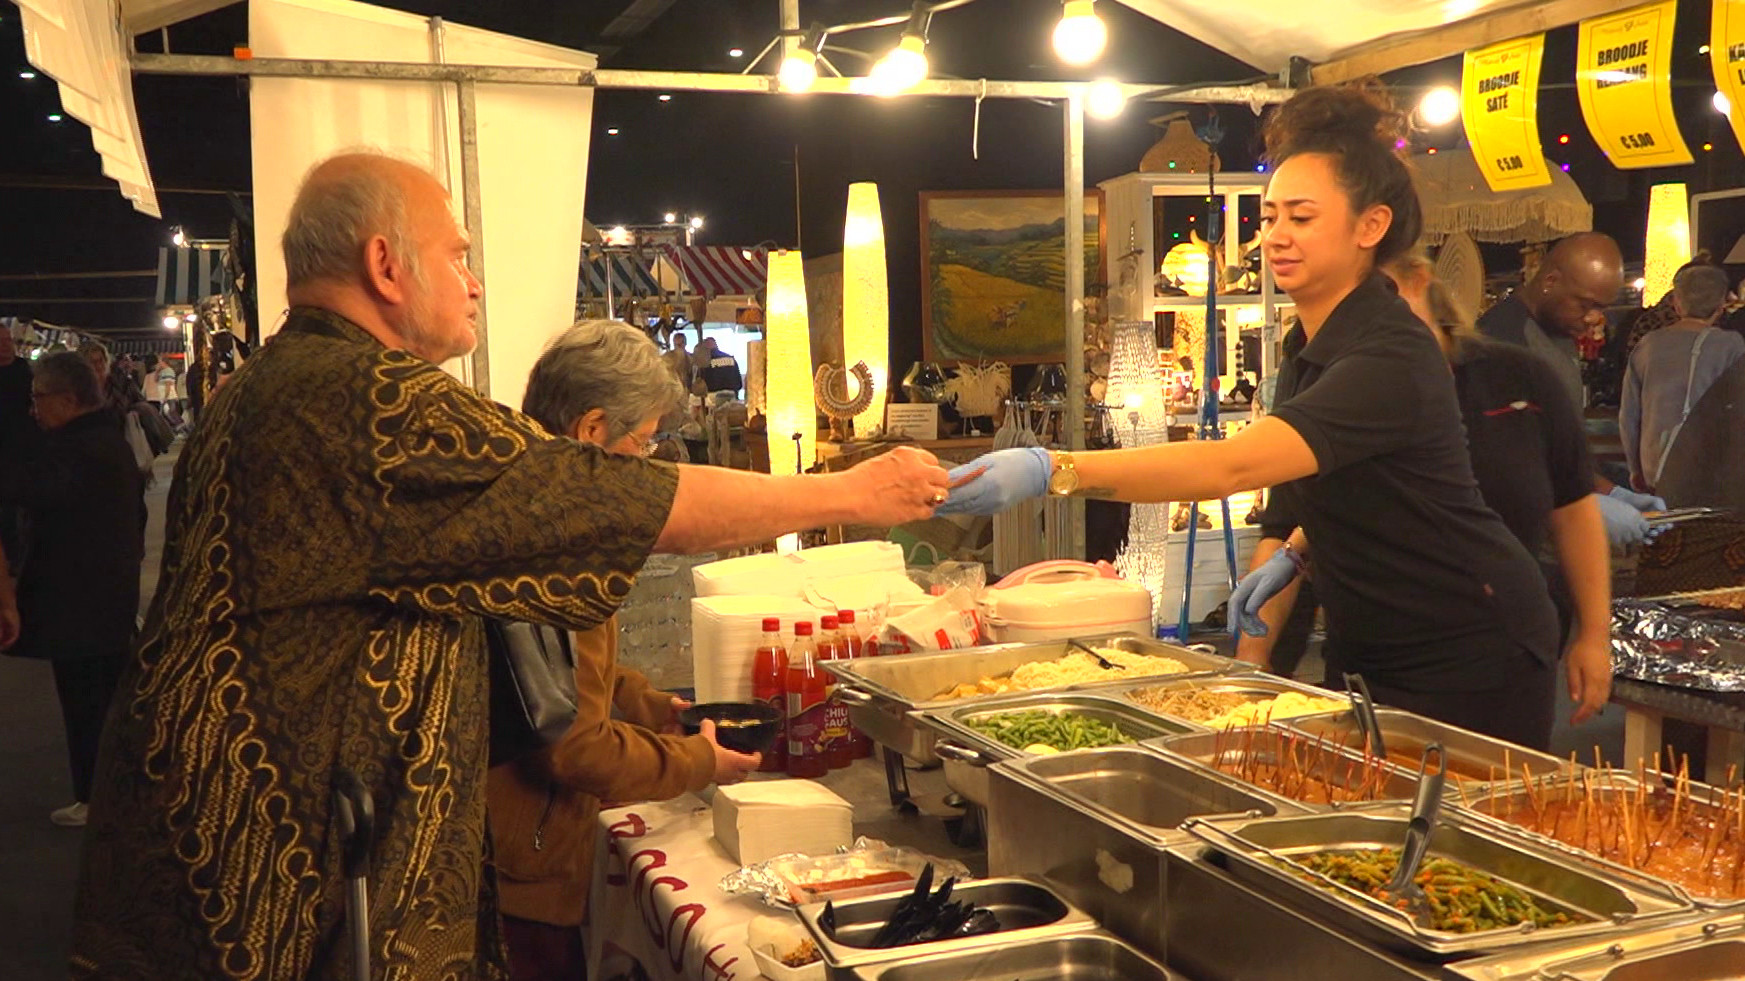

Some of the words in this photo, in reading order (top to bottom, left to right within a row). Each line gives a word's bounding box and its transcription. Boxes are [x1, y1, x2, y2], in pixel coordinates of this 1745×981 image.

[1598, 39, 1649, 66] BROODJE
[1479, 71, 1520, 94] BROODJE
[1487, 91, 1508, 112] SATÉ
